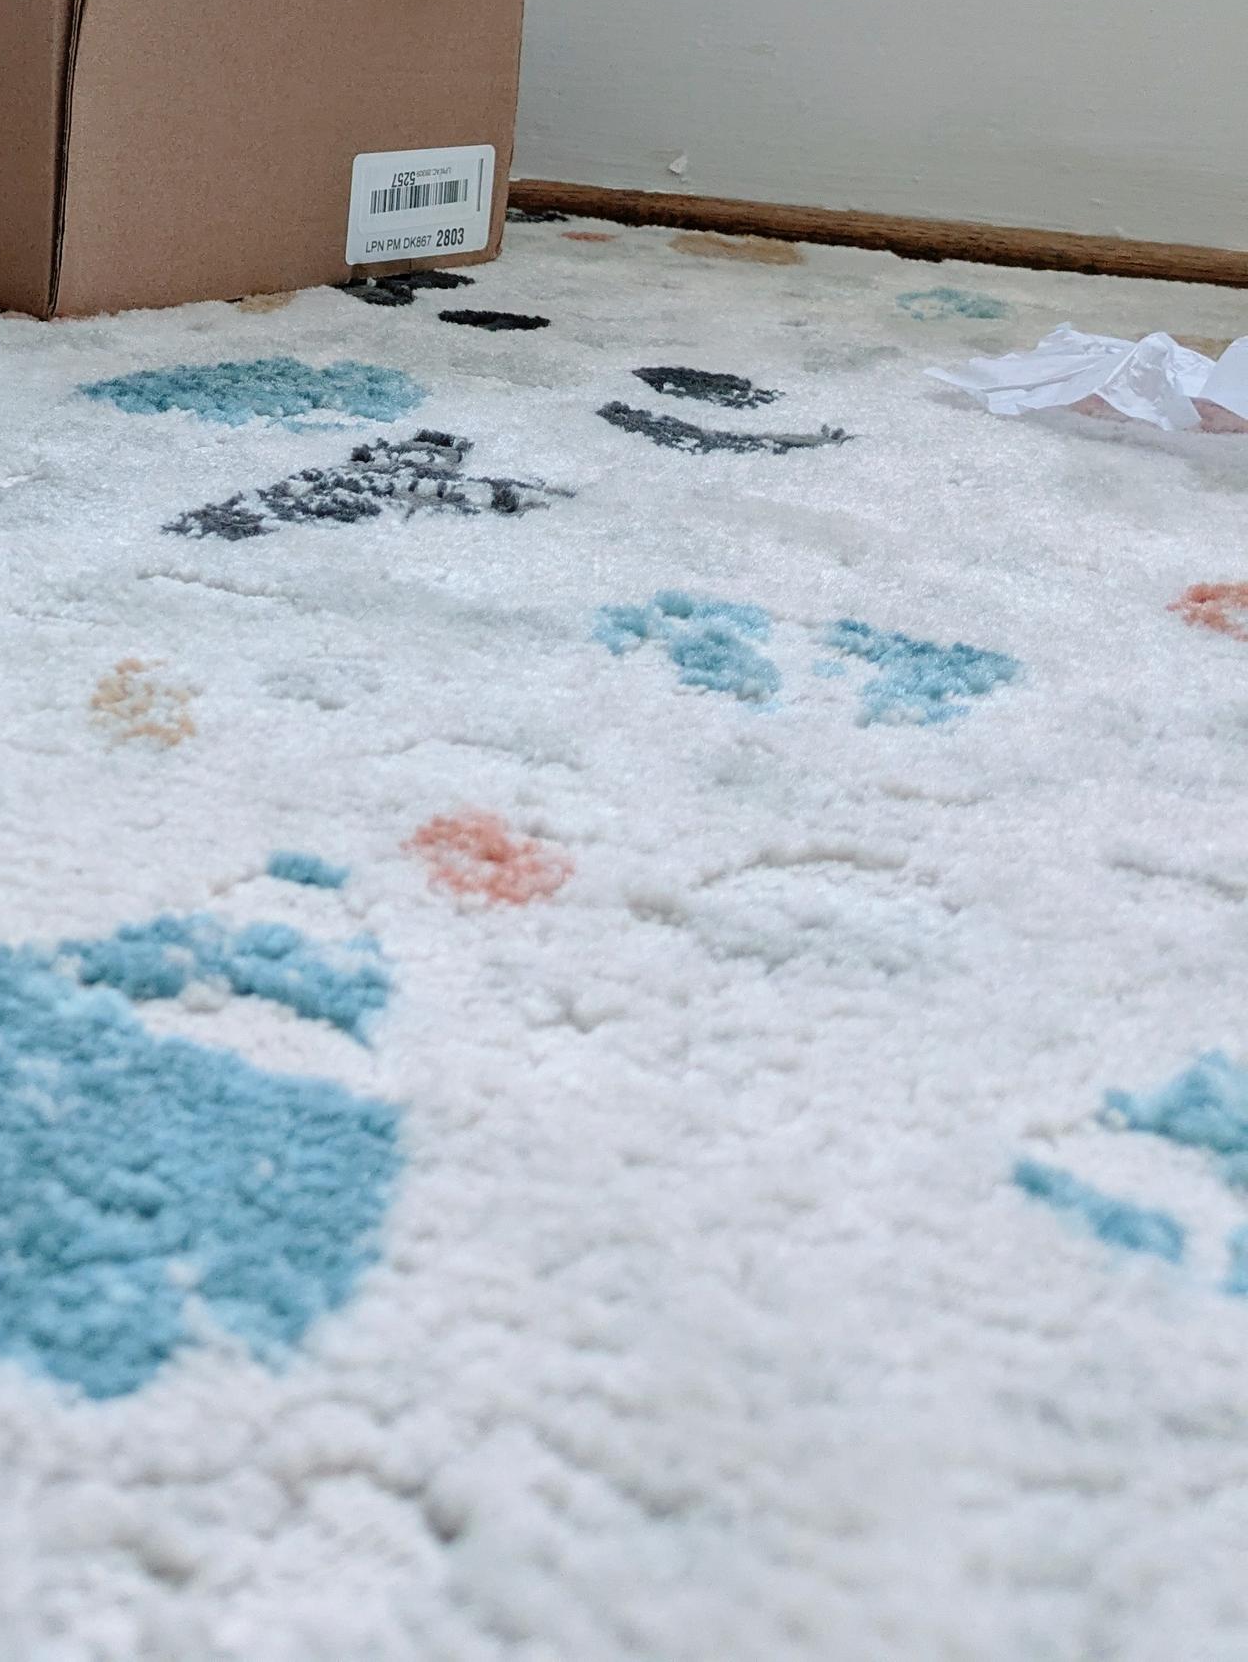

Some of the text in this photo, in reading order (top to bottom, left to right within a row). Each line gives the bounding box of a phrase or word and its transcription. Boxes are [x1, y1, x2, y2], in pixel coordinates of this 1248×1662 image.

[392, 171, 415, 187] 5257
[365, 240, 384, 253] LPN
[386, 238, 400, 250] PM
[436, 227, 464, 247] 2803
